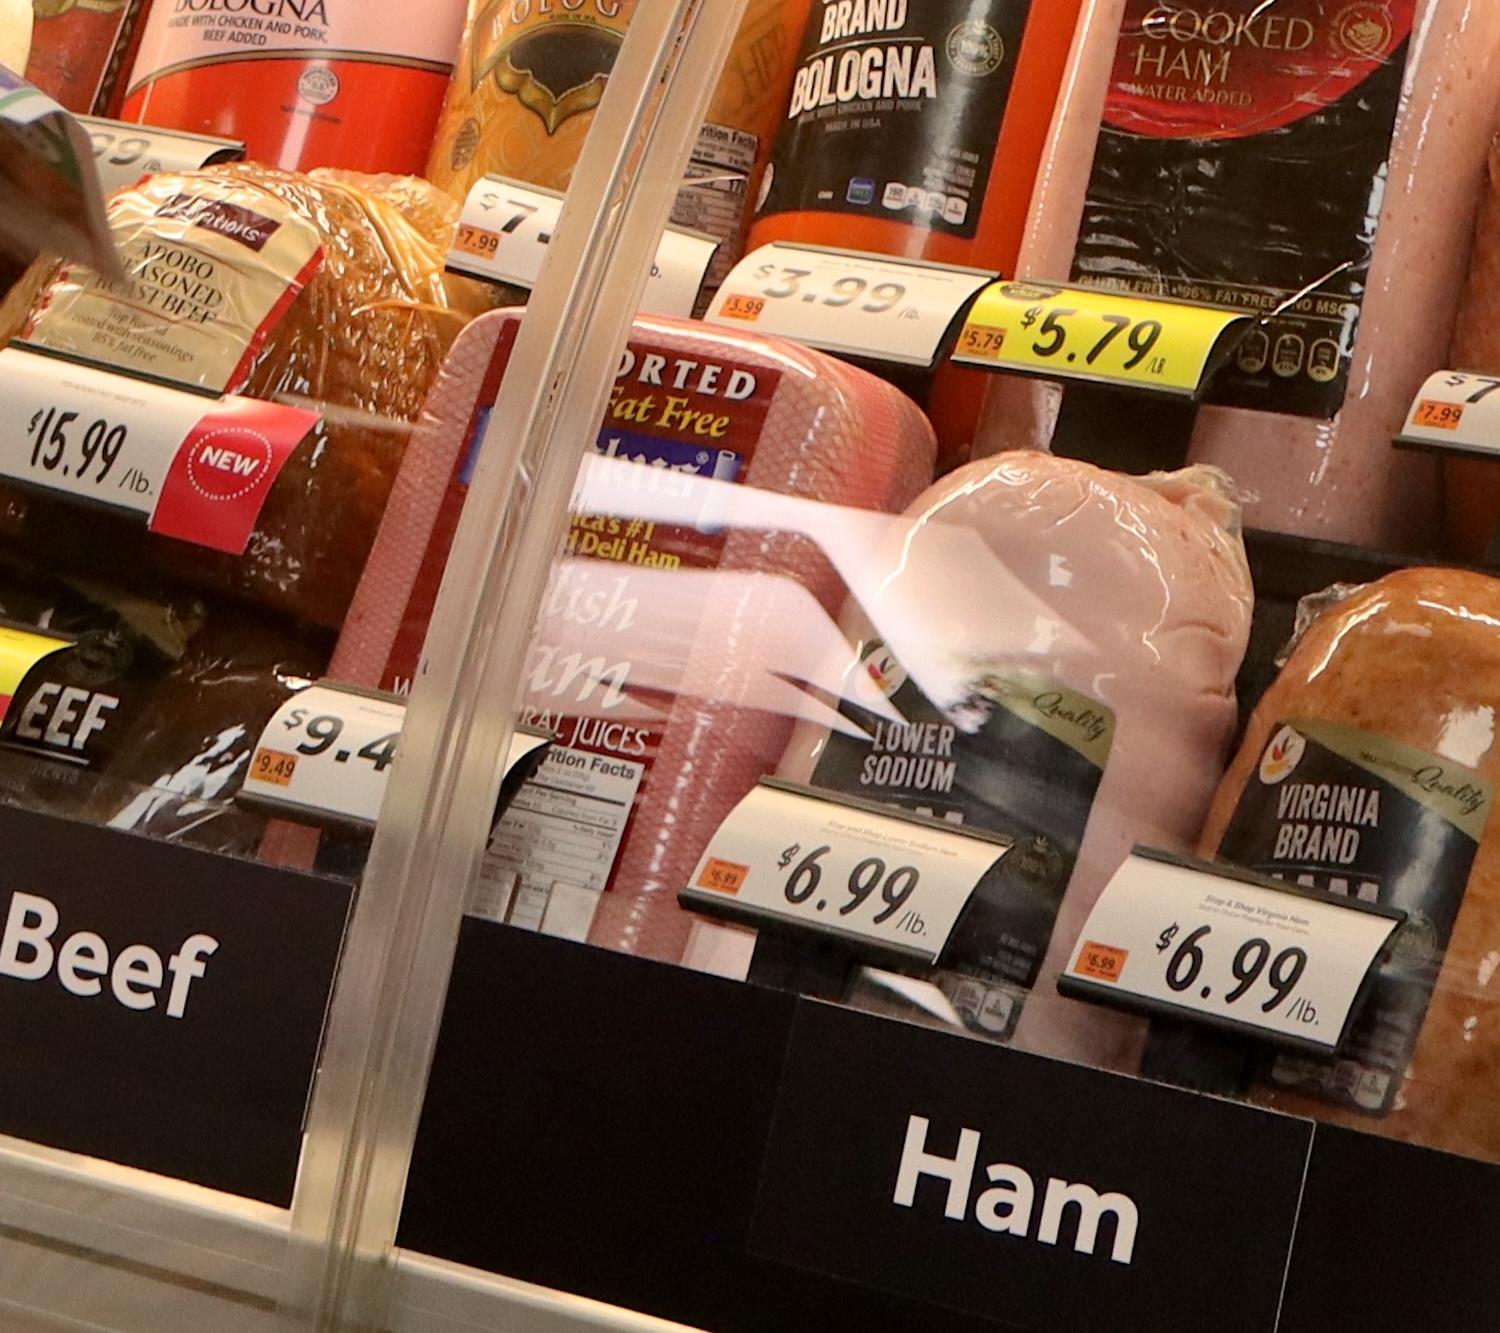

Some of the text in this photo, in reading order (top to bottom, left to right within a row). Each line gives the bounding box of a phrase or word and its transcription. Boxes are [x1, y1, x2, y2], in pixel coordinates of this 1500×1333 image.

[202, 28, 267, 46] BEEF ADDED
[217, 15, 292, 35] CHICKEN AND
[1141, 6, 1315, 53] COOKED
[787, 44, 938, 121] BOLOGNA
[1132, 42, 1232, 86] HAM
[1127, 83, 1254, 108] WATER ADDED
[138, 243, 216, 282] ADOBO
[750, 263, 906, 313] $3.99
[1020, 306, 1164, 370] $5.79
[659, 393, 731, 439] Free
[26, 407, 154, 498] $15.99 /lb.
[199, 444, 261, 479] NEW
[577, 532, 683, 572] Deli Ham
[566, 713, 651, 759] JUICES
[872, 719, 957, 758] LOWER
[1028, 689, 1110, 743] Quality
[595, 755, 638, 781] Facts
[859, 753, 957, 795] SODIUM
[1411, 760, 1486, 817] Quality
[1276, 782, 1381, 829] VIRGINIA
[1273, 823, 1361, 866] BRAND
[776, 842, 928, 937] $6.99 /lb.
[1155, 921, 1320, 1026] $6.99 /lb.
[892, 1114, 1140, 1267] Ham
